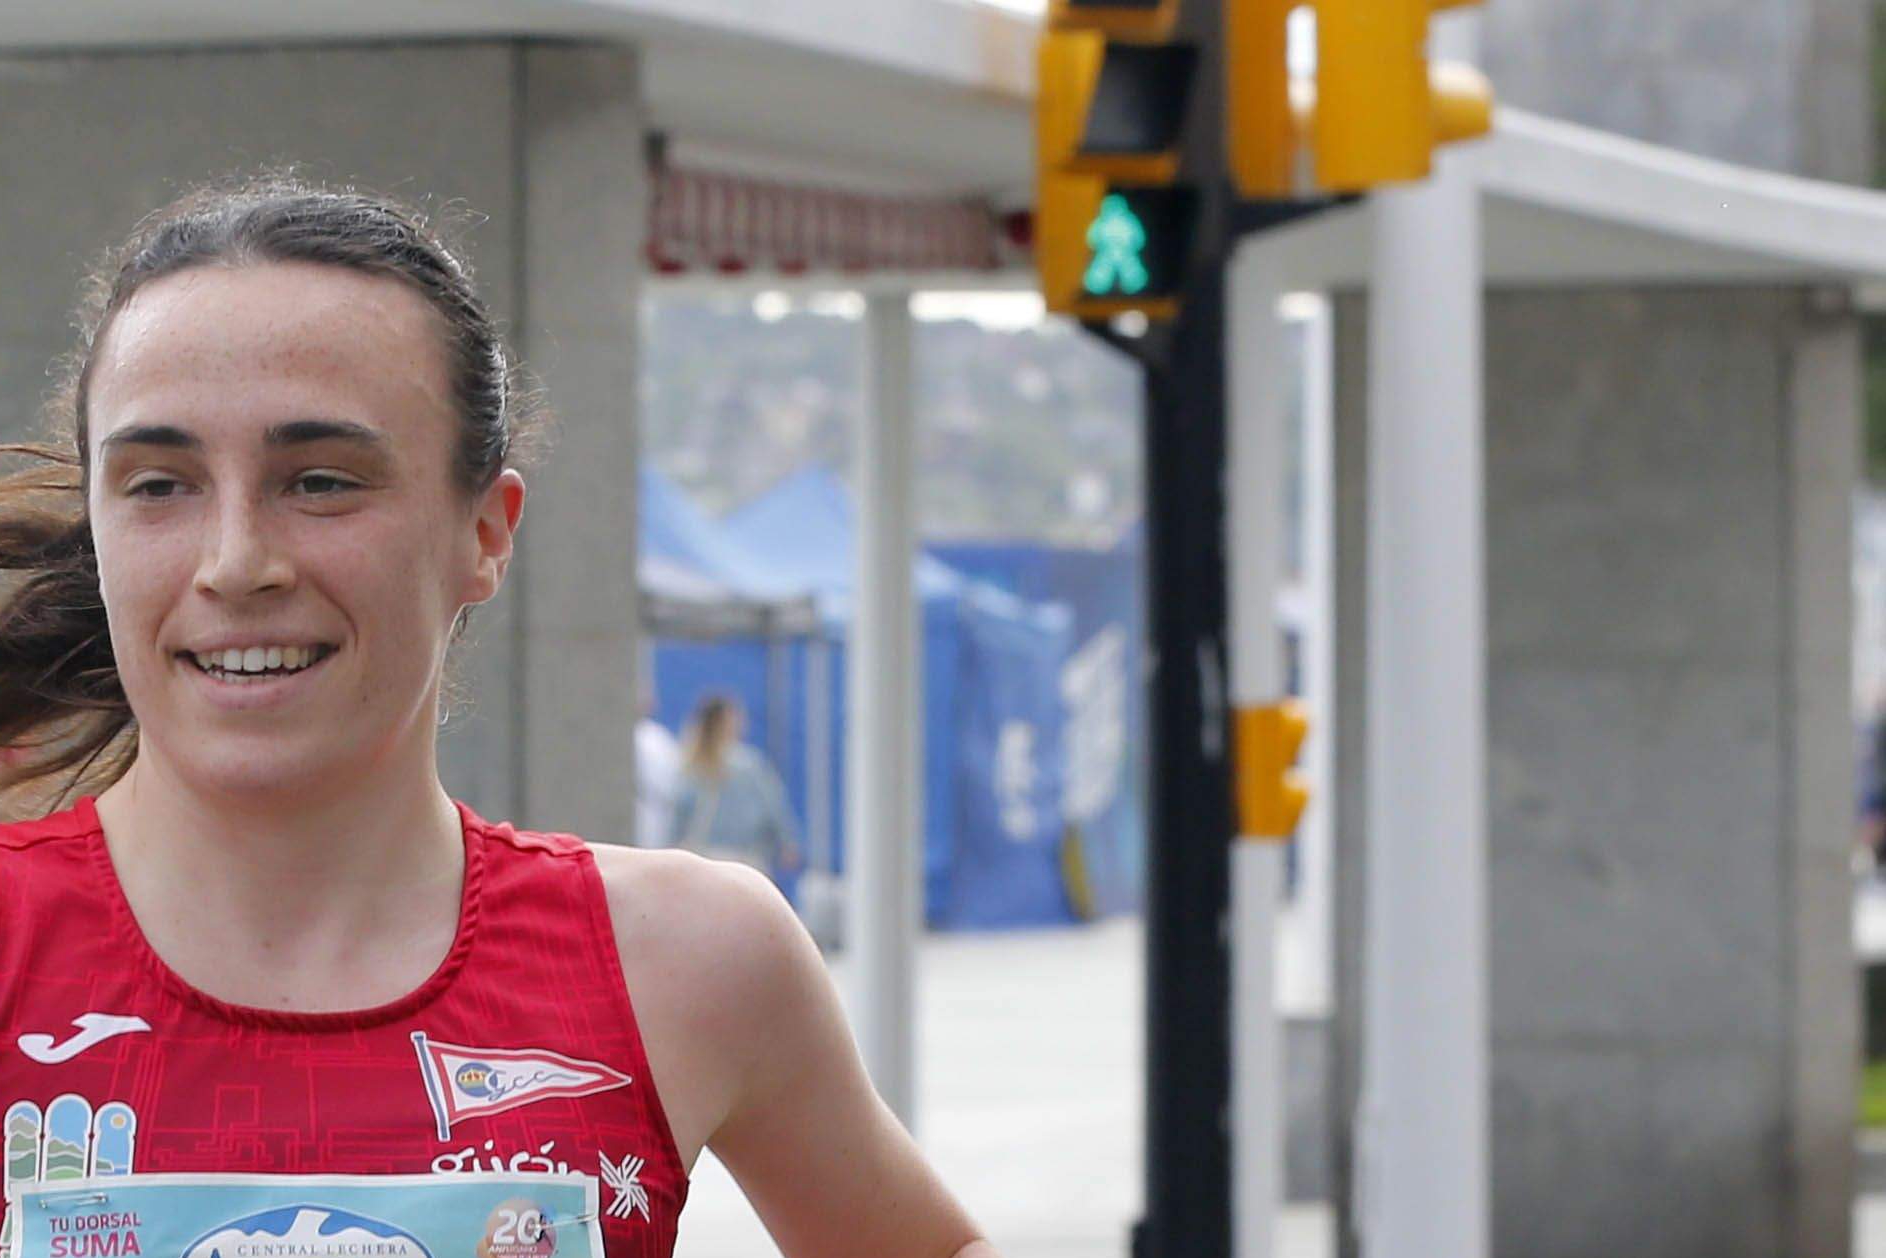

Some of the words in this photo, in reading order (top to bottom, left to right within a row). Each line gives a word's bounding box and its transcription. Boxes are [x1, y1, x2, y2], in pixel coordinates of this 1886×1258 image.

[49, 1217, 70, 1233] TU
[75, 1212, 141, 1232] DORSAL
[50, 1231, 141, 1258] SUMA
[237, 1243, 316, 1257] CENTRAL
[327, 1243, 408, 1256] LECHERA
